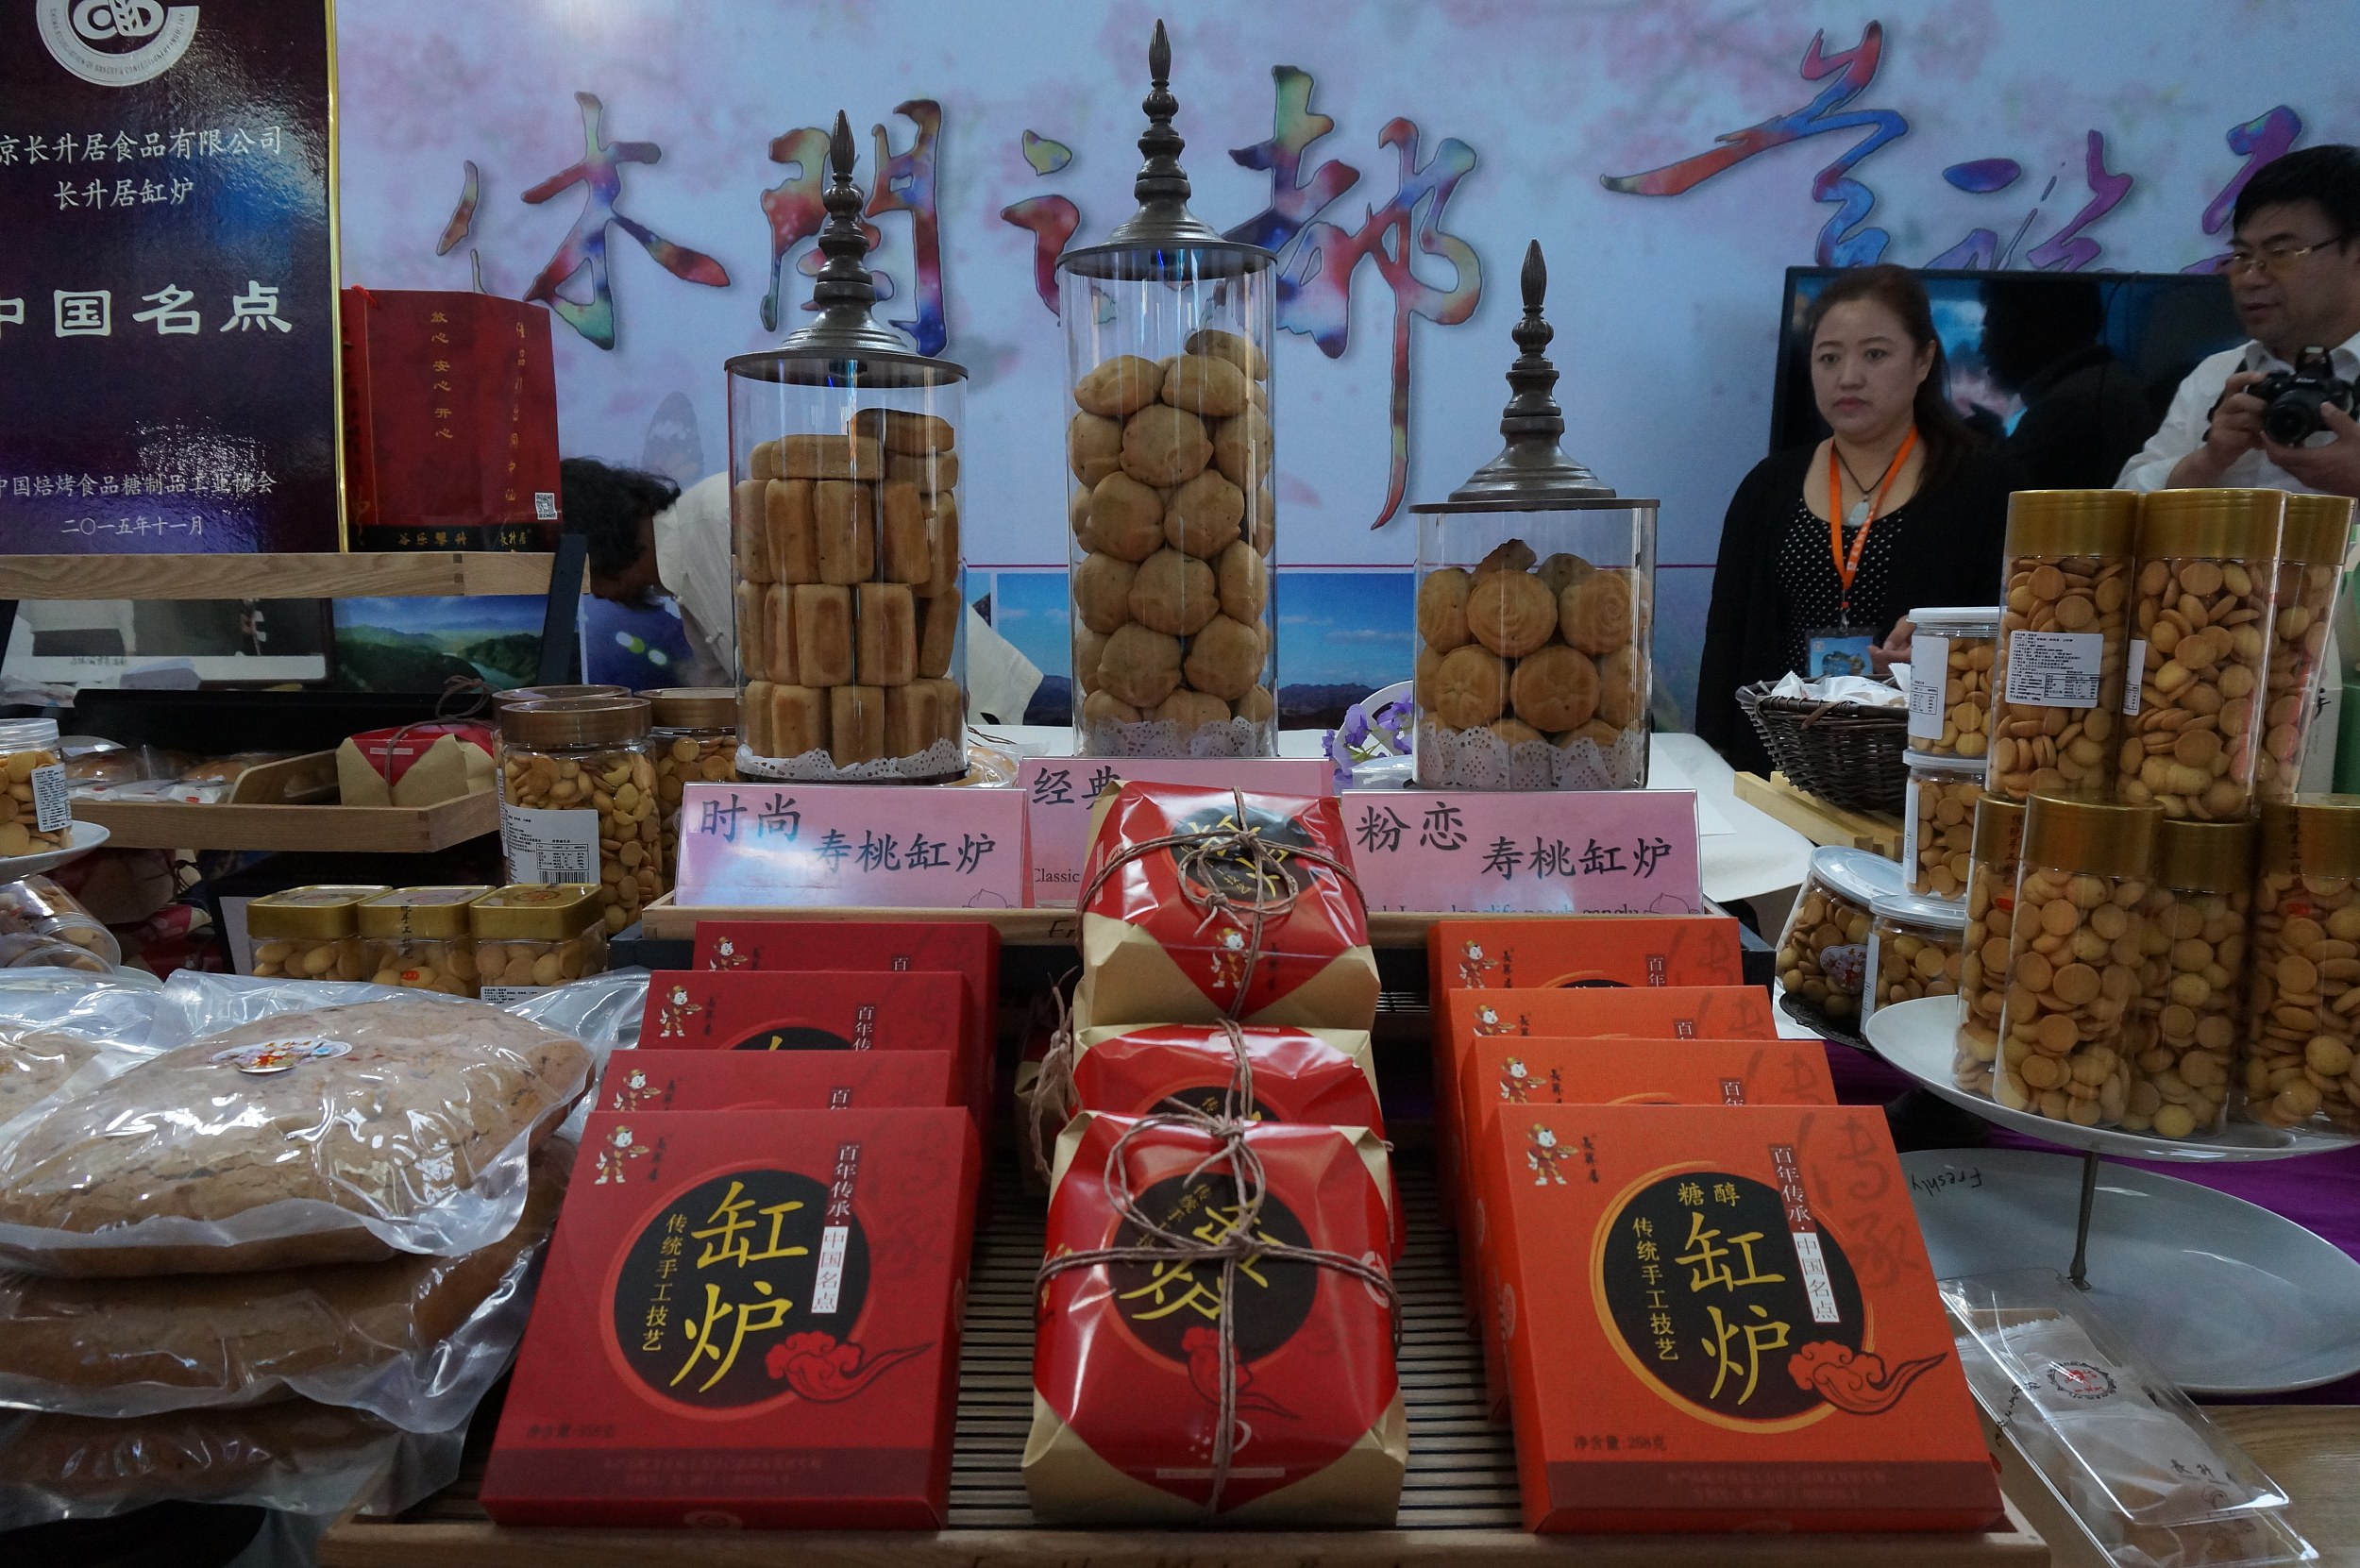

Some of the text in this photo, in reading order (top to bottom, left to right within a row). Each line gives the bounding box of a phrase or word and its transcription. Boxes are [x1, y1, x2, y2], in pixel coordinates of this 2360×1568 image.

[0, 125, 282, 166] 京长升居食品有限公司
[53, 177, 194, 211] 长升居缸炉
[1032, 765, 1121, 810] 经典
[700, 792, 801, 844] 时尚
[1354, 801, 1469, 853] 粉恋
[812, 828, 997, 875] 寿桃缸炉
[1480, 835, 1673, 880] 寿桃缸炉
[892, 956, 909, 971] 百
[1646, 956, 1666, 986] 百年
[852, 1005, 875, 1050] 百年传
[1677, 1182, 1741, 1206] 糖醇
[1912, 1167, 1982, 1197] Freshly
[642, 1213, 689, 1353] 传统手工技艺
[669, 1181, 809, 1393] 缸炉
[1632, 1217, 1678, 1360] 传统手工技艺
[1675, 1211, 1791, 1405] 缸炉
